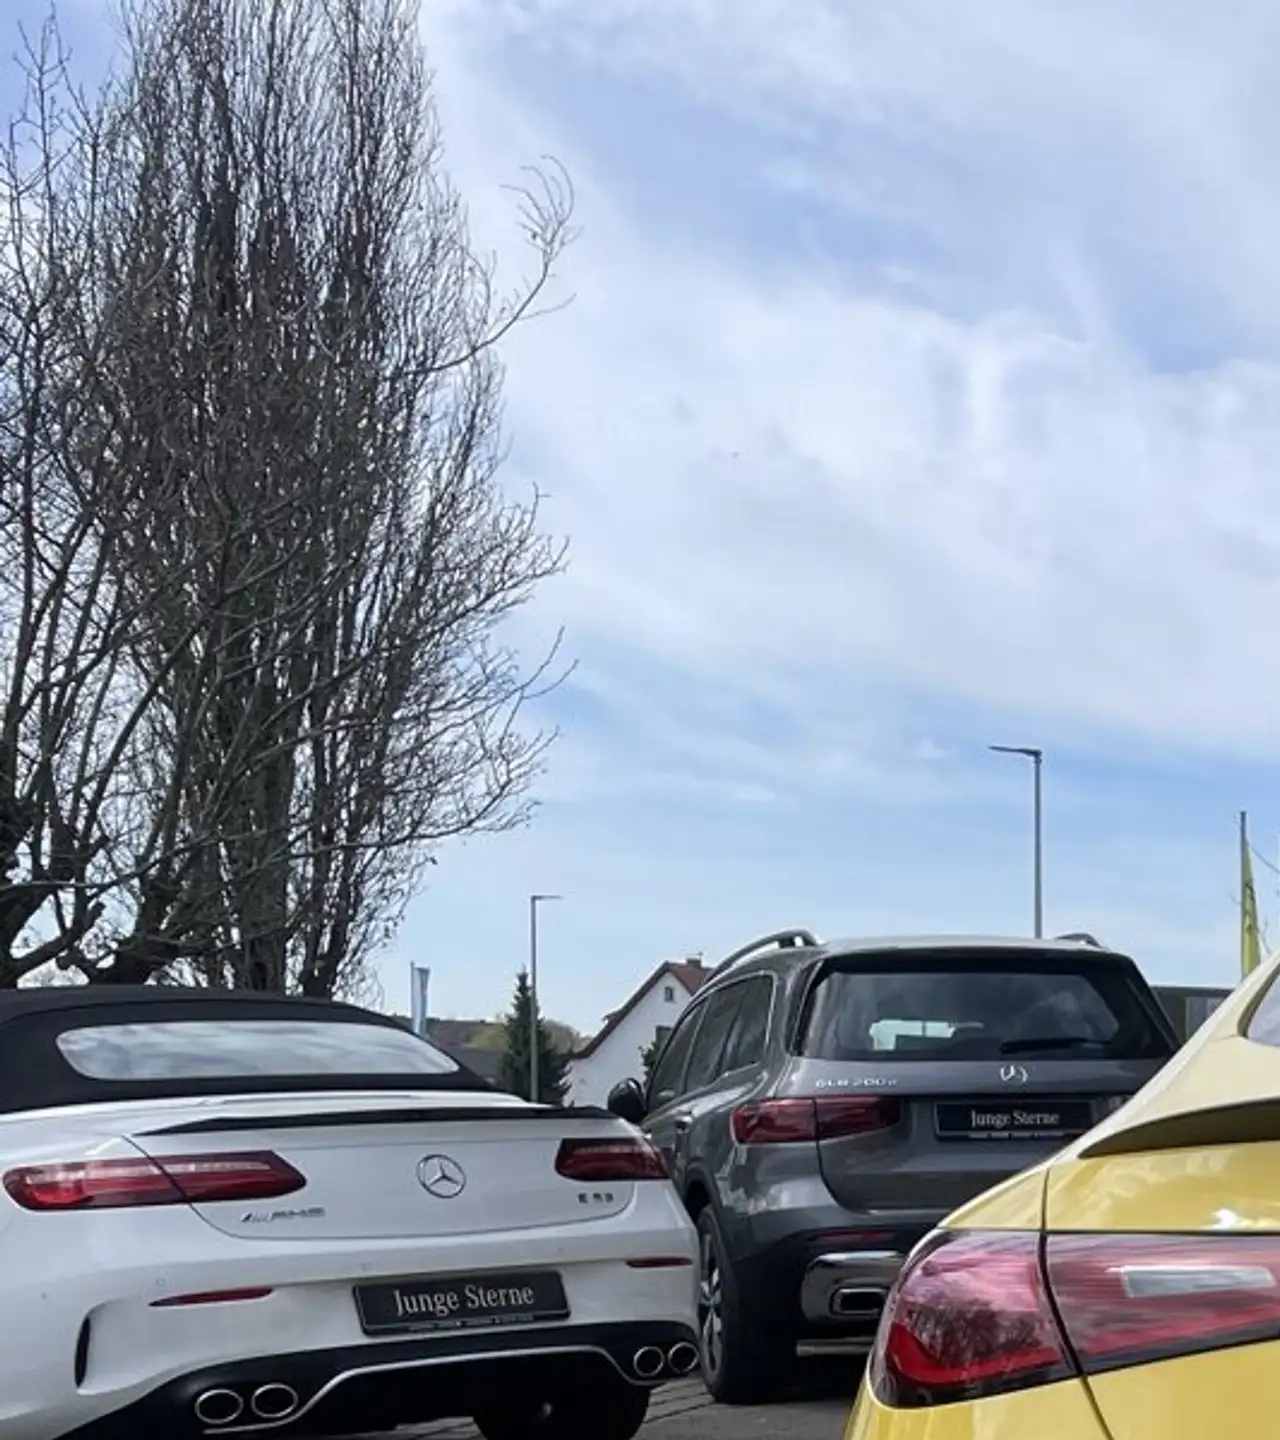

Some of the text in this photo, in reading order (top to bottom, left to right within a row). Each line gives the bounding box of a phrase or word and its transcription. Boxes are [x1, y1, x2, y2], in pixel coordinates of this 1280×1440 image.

[971, 1108, 1060, 1129] Junge Sterne
[393, 1284, 535, 1317] Junge Sterne
